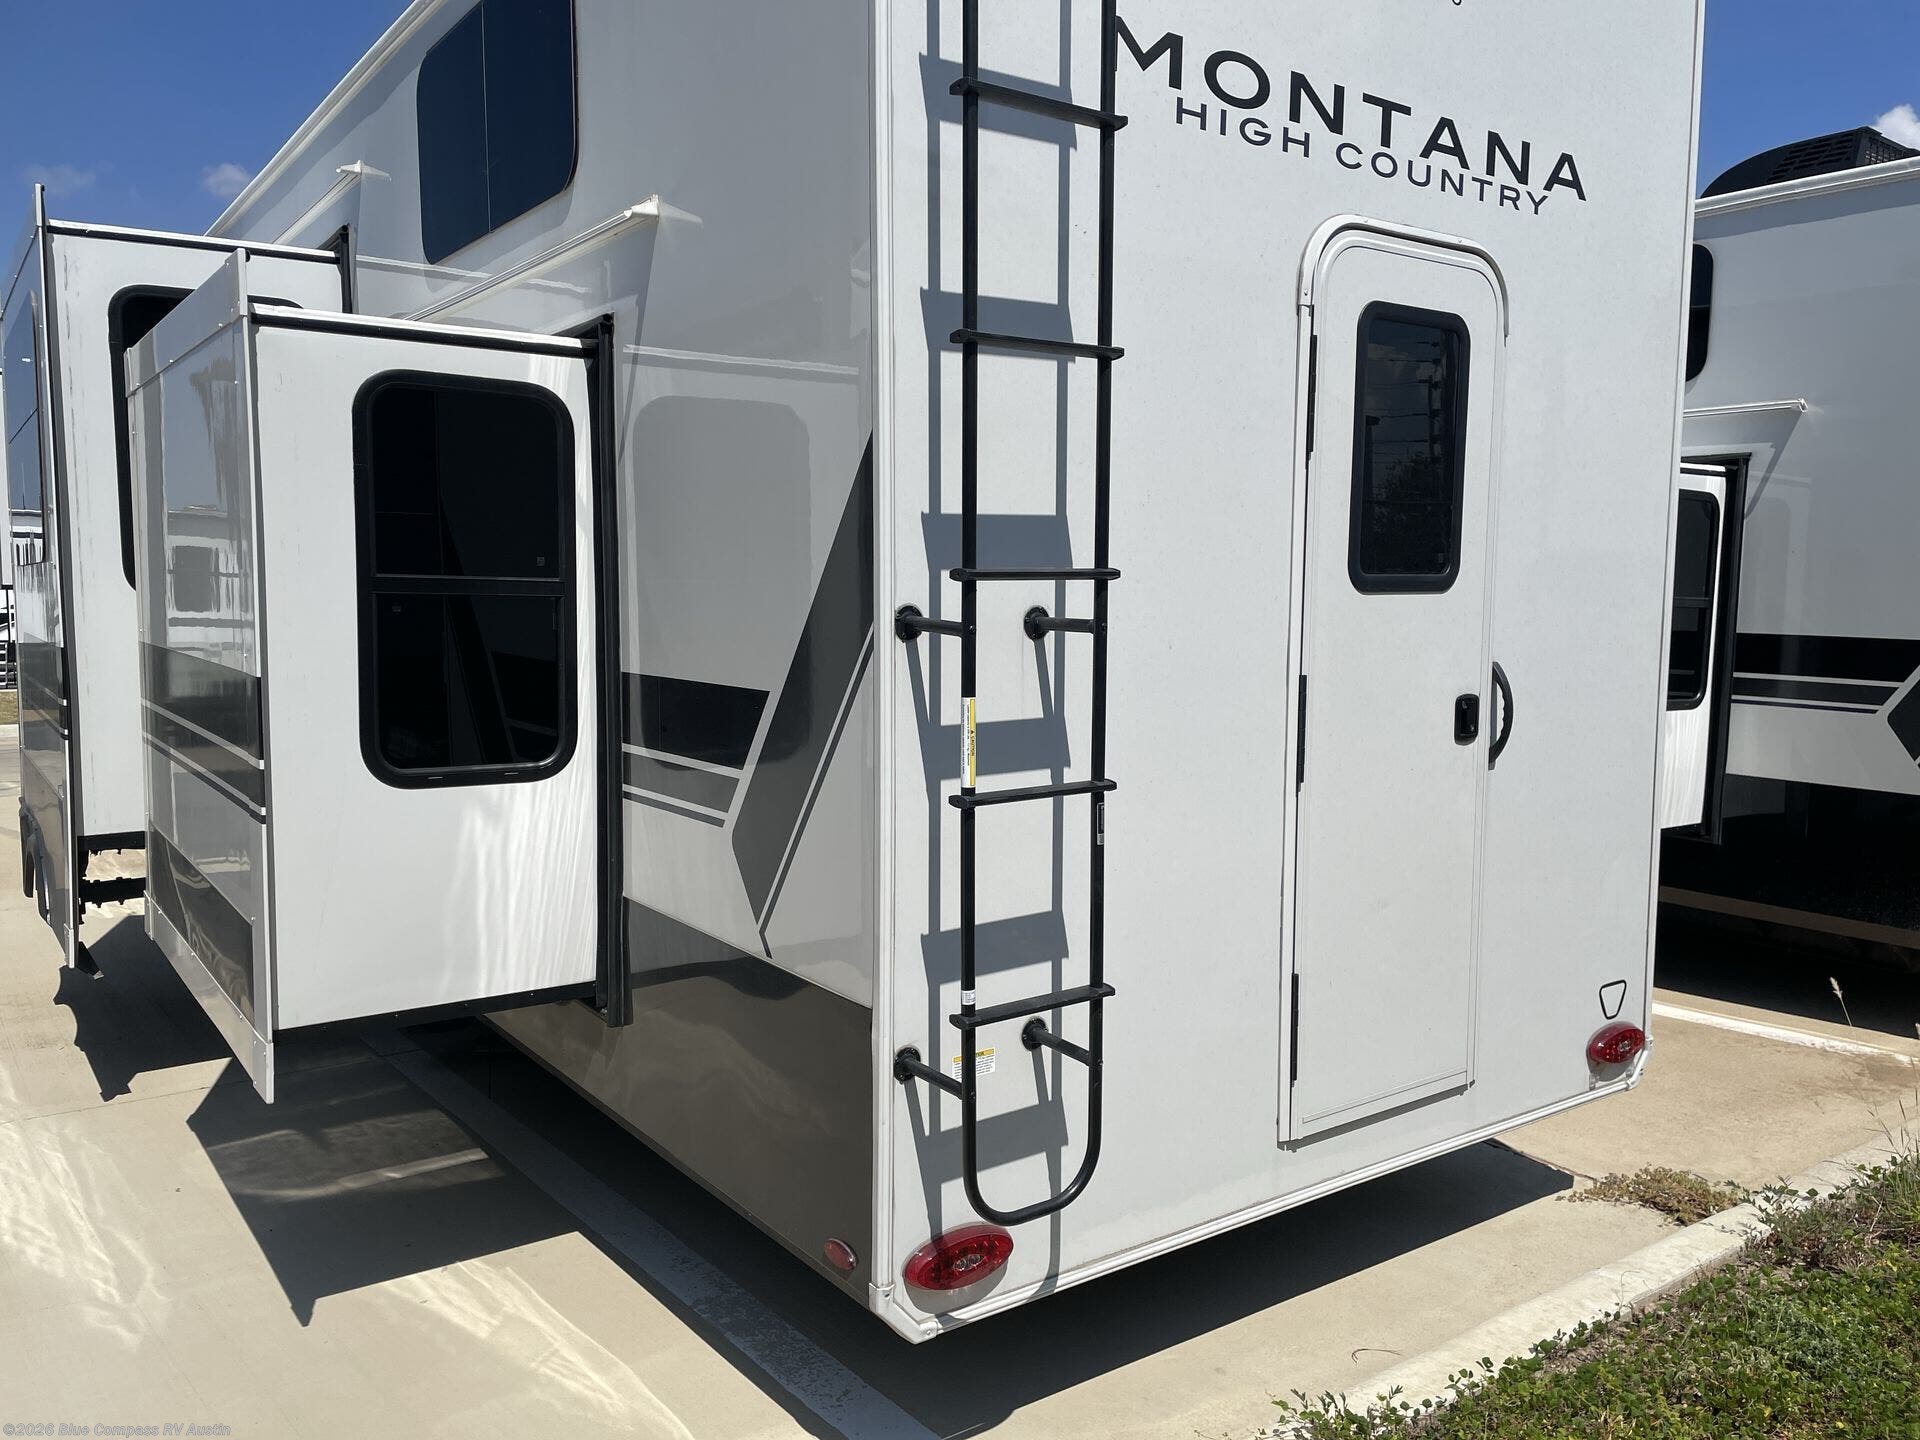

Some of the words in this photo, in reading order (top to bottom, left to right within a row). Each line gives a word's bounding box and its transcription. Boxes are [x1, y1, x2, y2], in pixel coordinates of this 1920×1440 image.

[1115, 15, 1587, 201] MONTANA
[1176, 97, 1310, 158] HIGH
[1335, 142, 1548, 215] COUNTRY
